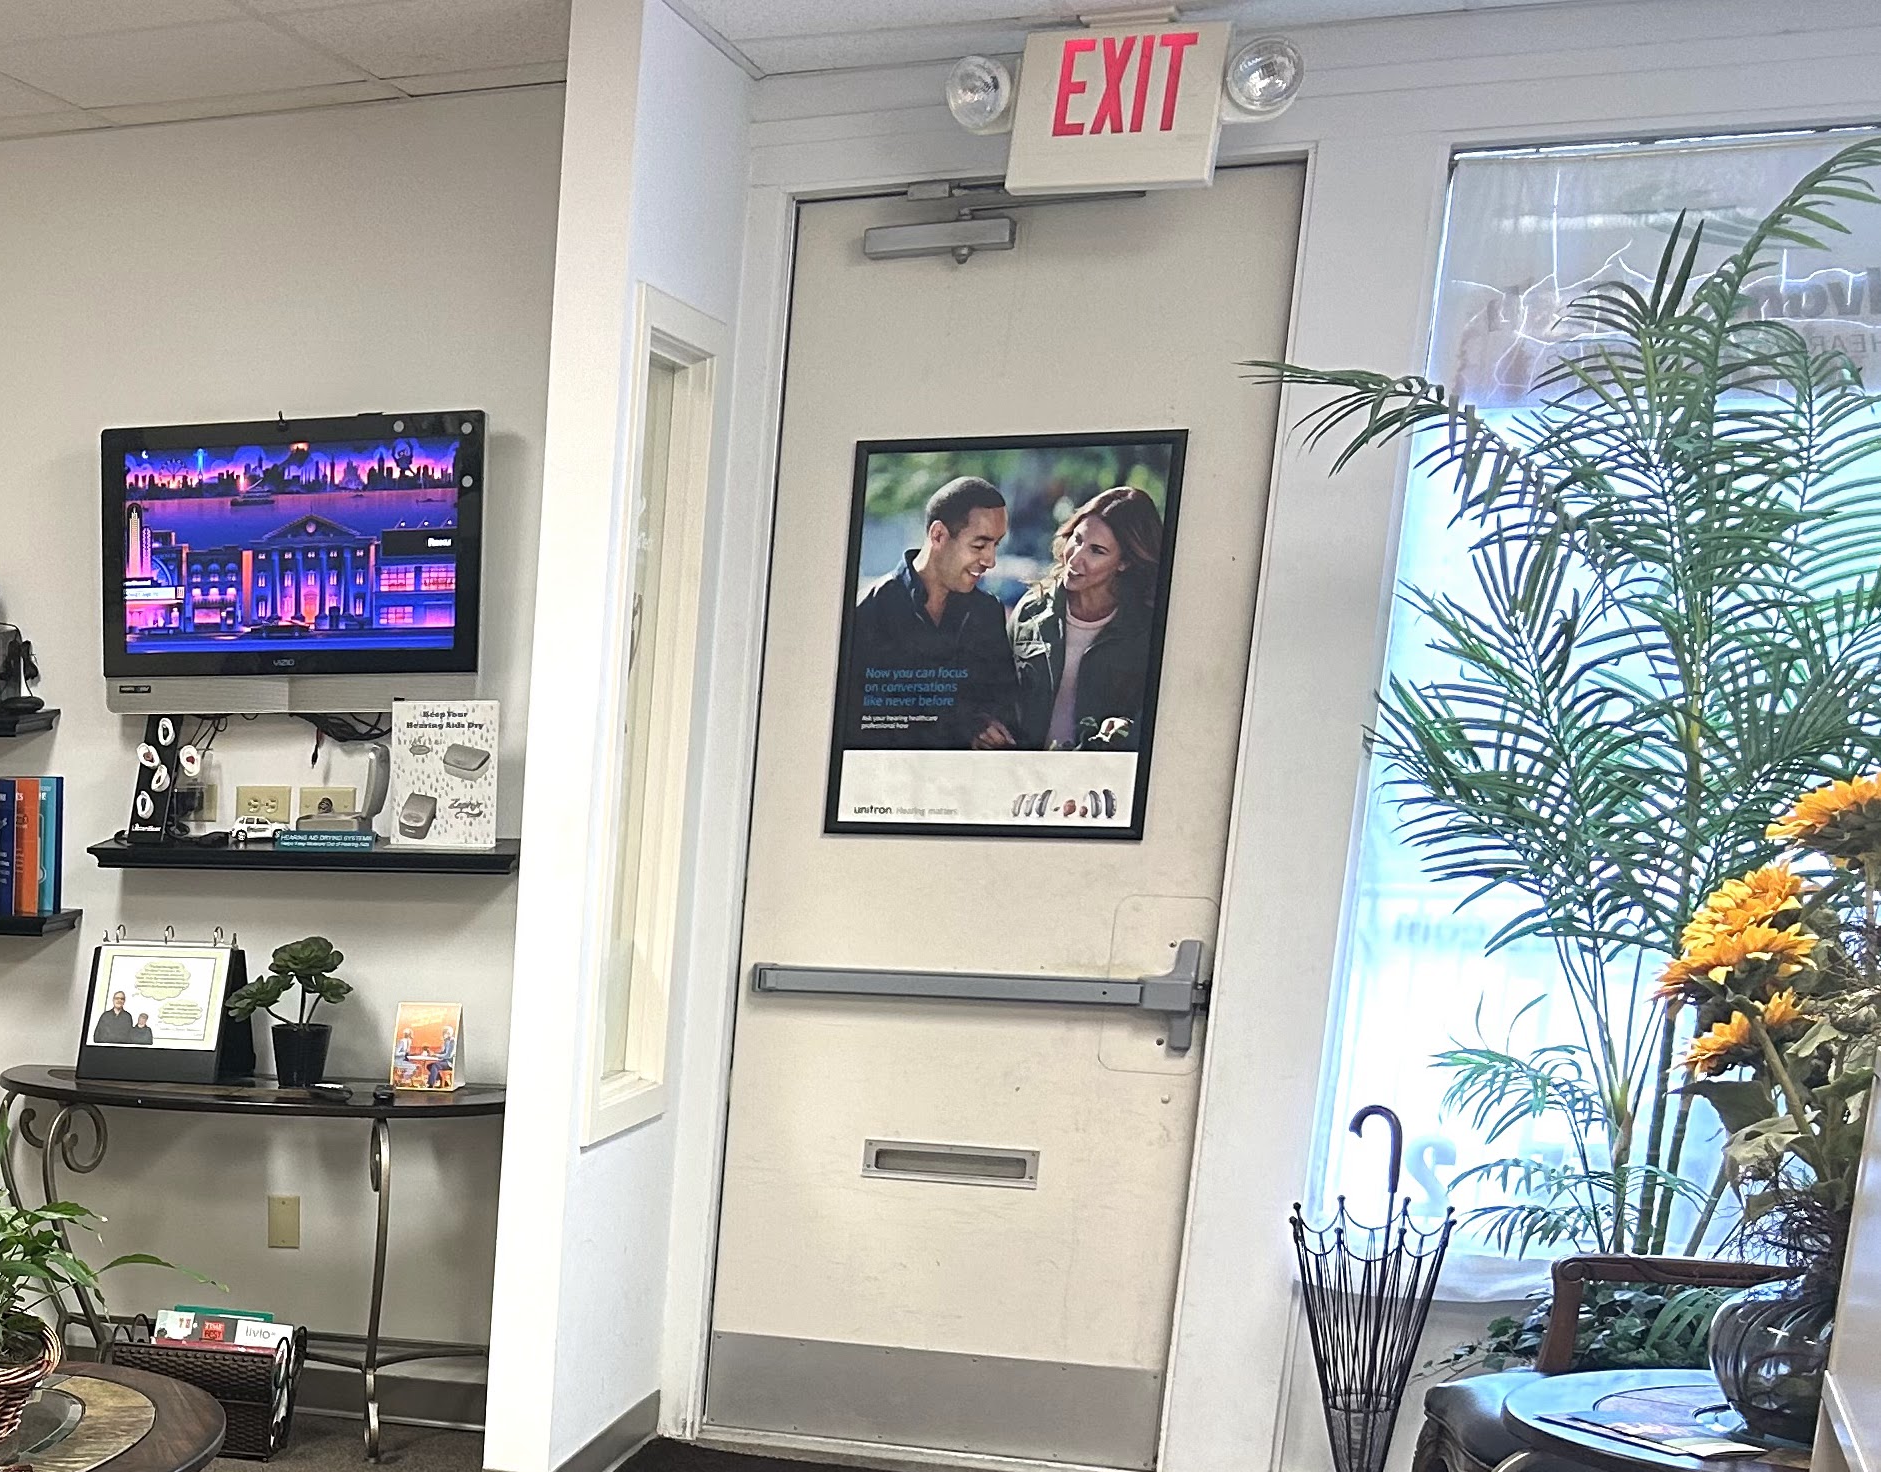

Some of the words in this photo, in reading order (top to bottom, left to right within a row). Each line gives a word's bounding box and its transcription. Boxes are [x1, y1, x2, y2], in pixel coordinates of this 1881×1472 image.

[1052, 32, 1199, 137] EXIT
[865, 667, 890, 679] Now
[893, 669, 914, 680] you
[915, 669, 935, 679] can
[938, 666, 969, 679] focus
[864, 683, 878, 692] on
[881, 681, 958, 692] conversations
[863, 694, 883, 706] like
[885, 696, 916, 706] never
[919, 695, 954, 706] before
[422, 711, 446, 719] Keep
[406, 722, 444, 730] Hearing
[467, 722, 484, 730] Dry
[853, 804, 892, 815] unitron
[246, 1326, 271, 1340] livio
